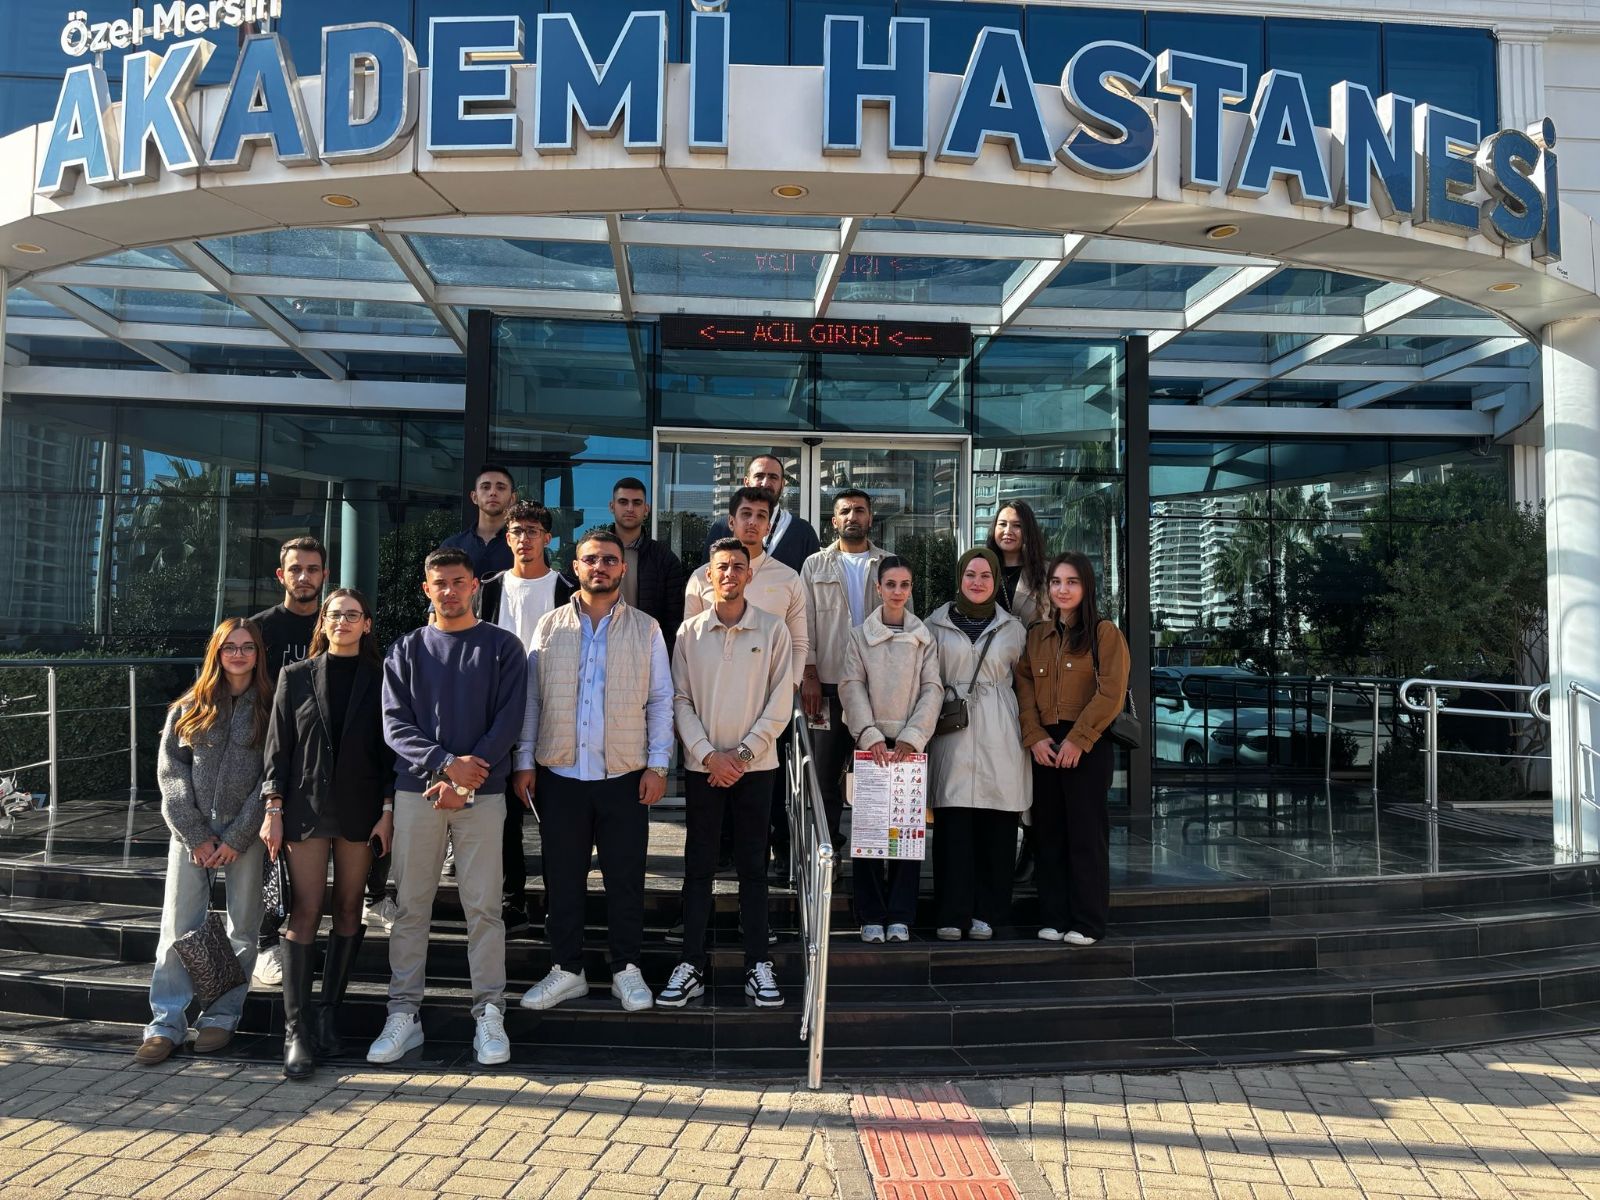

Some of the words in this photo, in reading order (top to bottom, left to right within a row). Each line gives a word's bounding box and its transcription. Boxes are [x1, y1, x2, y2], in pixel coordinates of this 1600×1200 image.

[61, 8, 143, 56] Özel
[36, 0, 730, 196] AKADEMİ
[823, 14, 1562, 264] HASTANESİ
